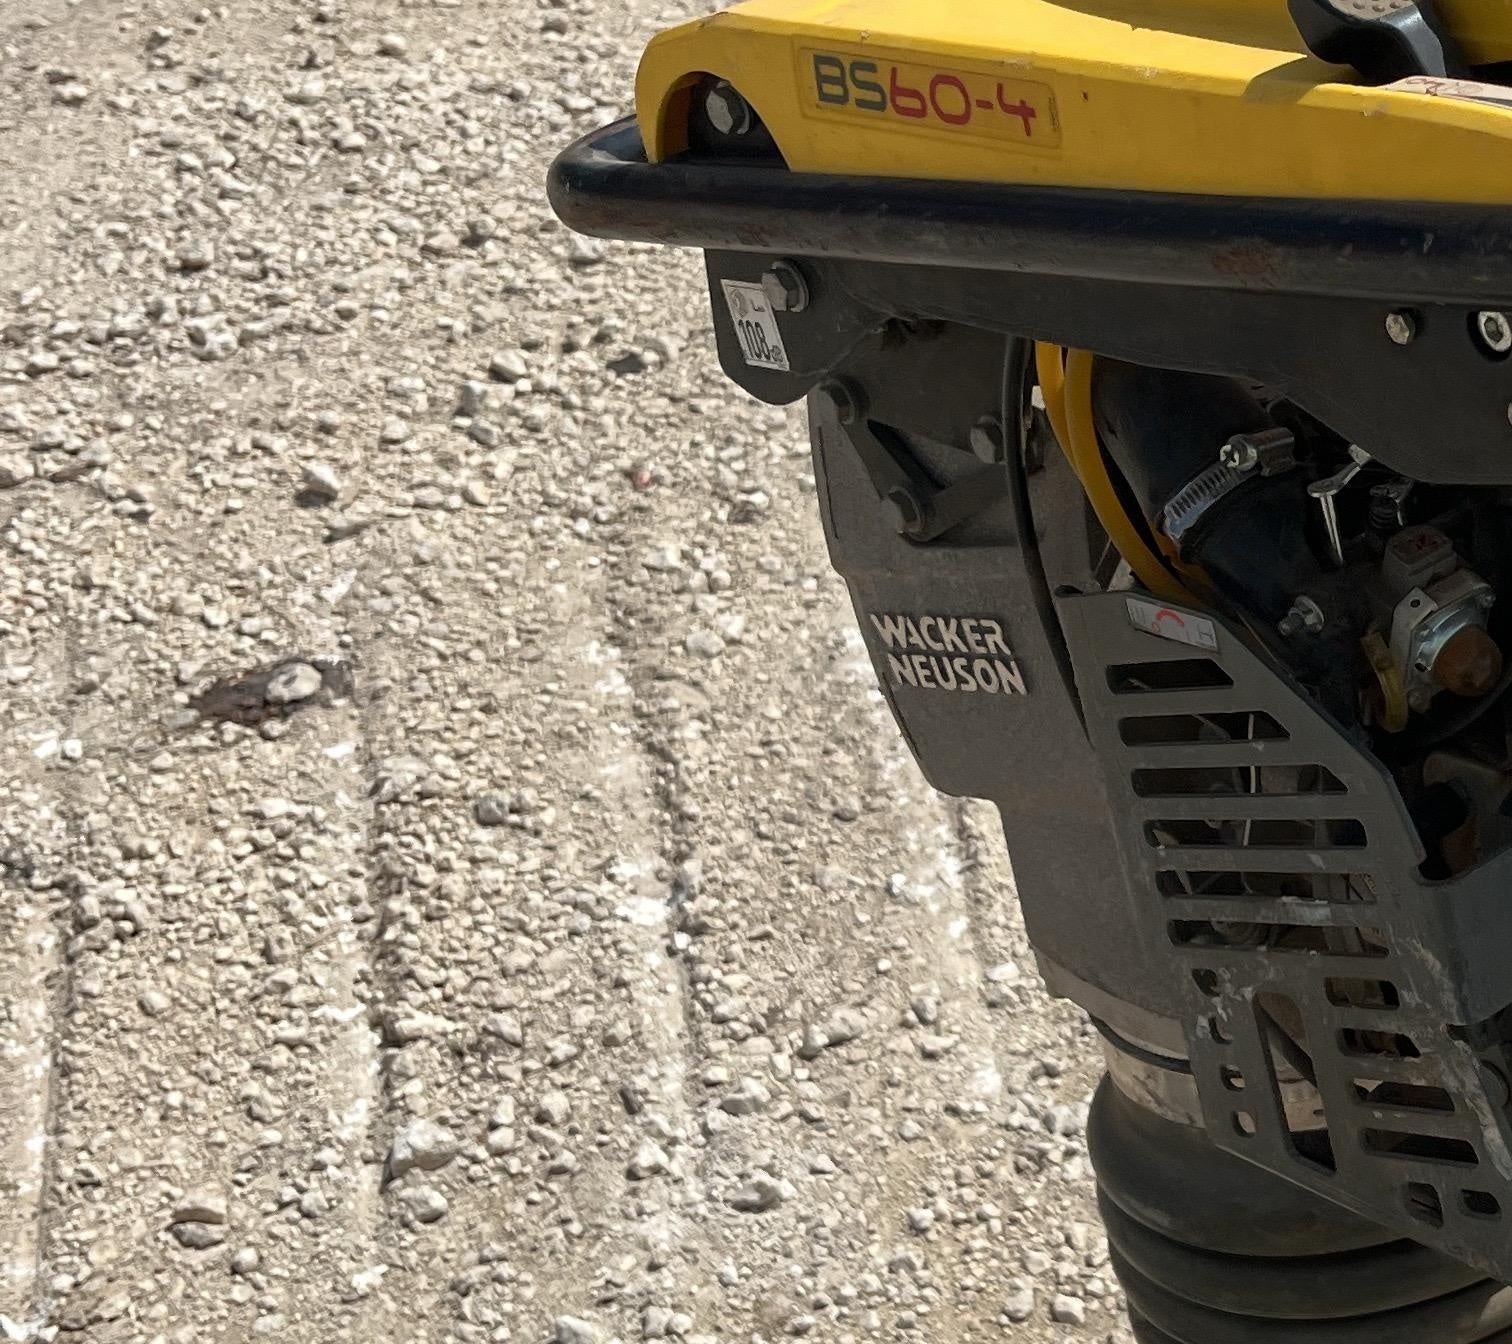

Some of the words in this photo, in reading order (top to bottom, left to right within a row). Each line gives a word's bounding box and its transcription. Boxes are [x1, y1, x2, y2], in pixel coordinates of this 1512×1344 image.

[812, 53, 1036, 137] BS60-4
[738, 319, 770, 361] 108
[870, 612, 1012, 656] WACKER
[887, 653, 1028, 696] NEUSON
